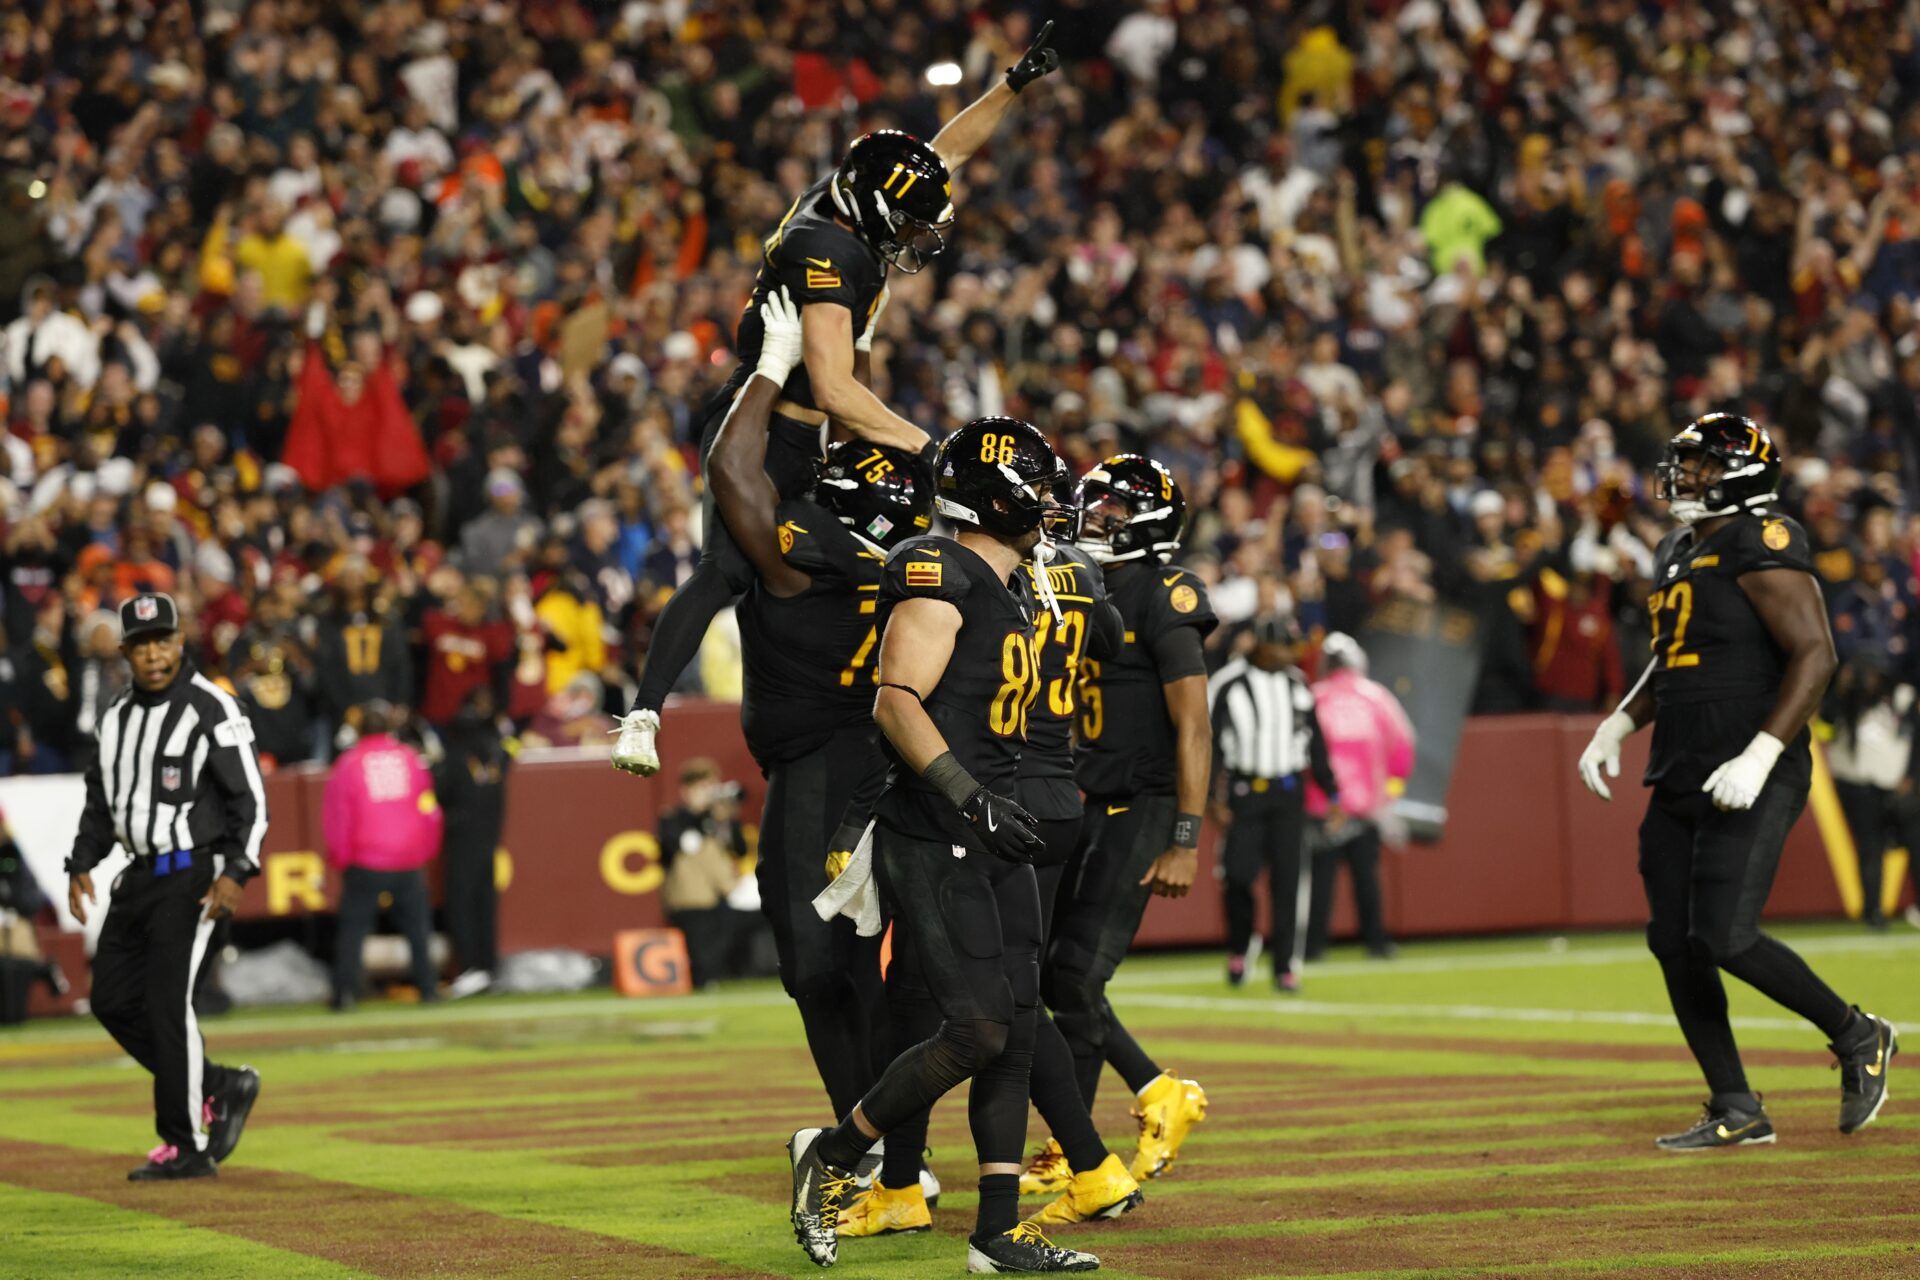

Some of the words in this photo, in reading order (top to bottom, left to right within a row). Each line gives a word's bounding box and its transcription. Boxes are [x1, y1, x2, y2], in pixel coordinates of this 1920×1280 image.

[883, 162, 918, 200] 11
[854, 448, 895, 485] 75
[979, 432, 1016, 466] 86
[1160, 473, 1173, 501] 5
[1026, 567, 1077, 594] SOTT
[633, 938, 679, 986] G
